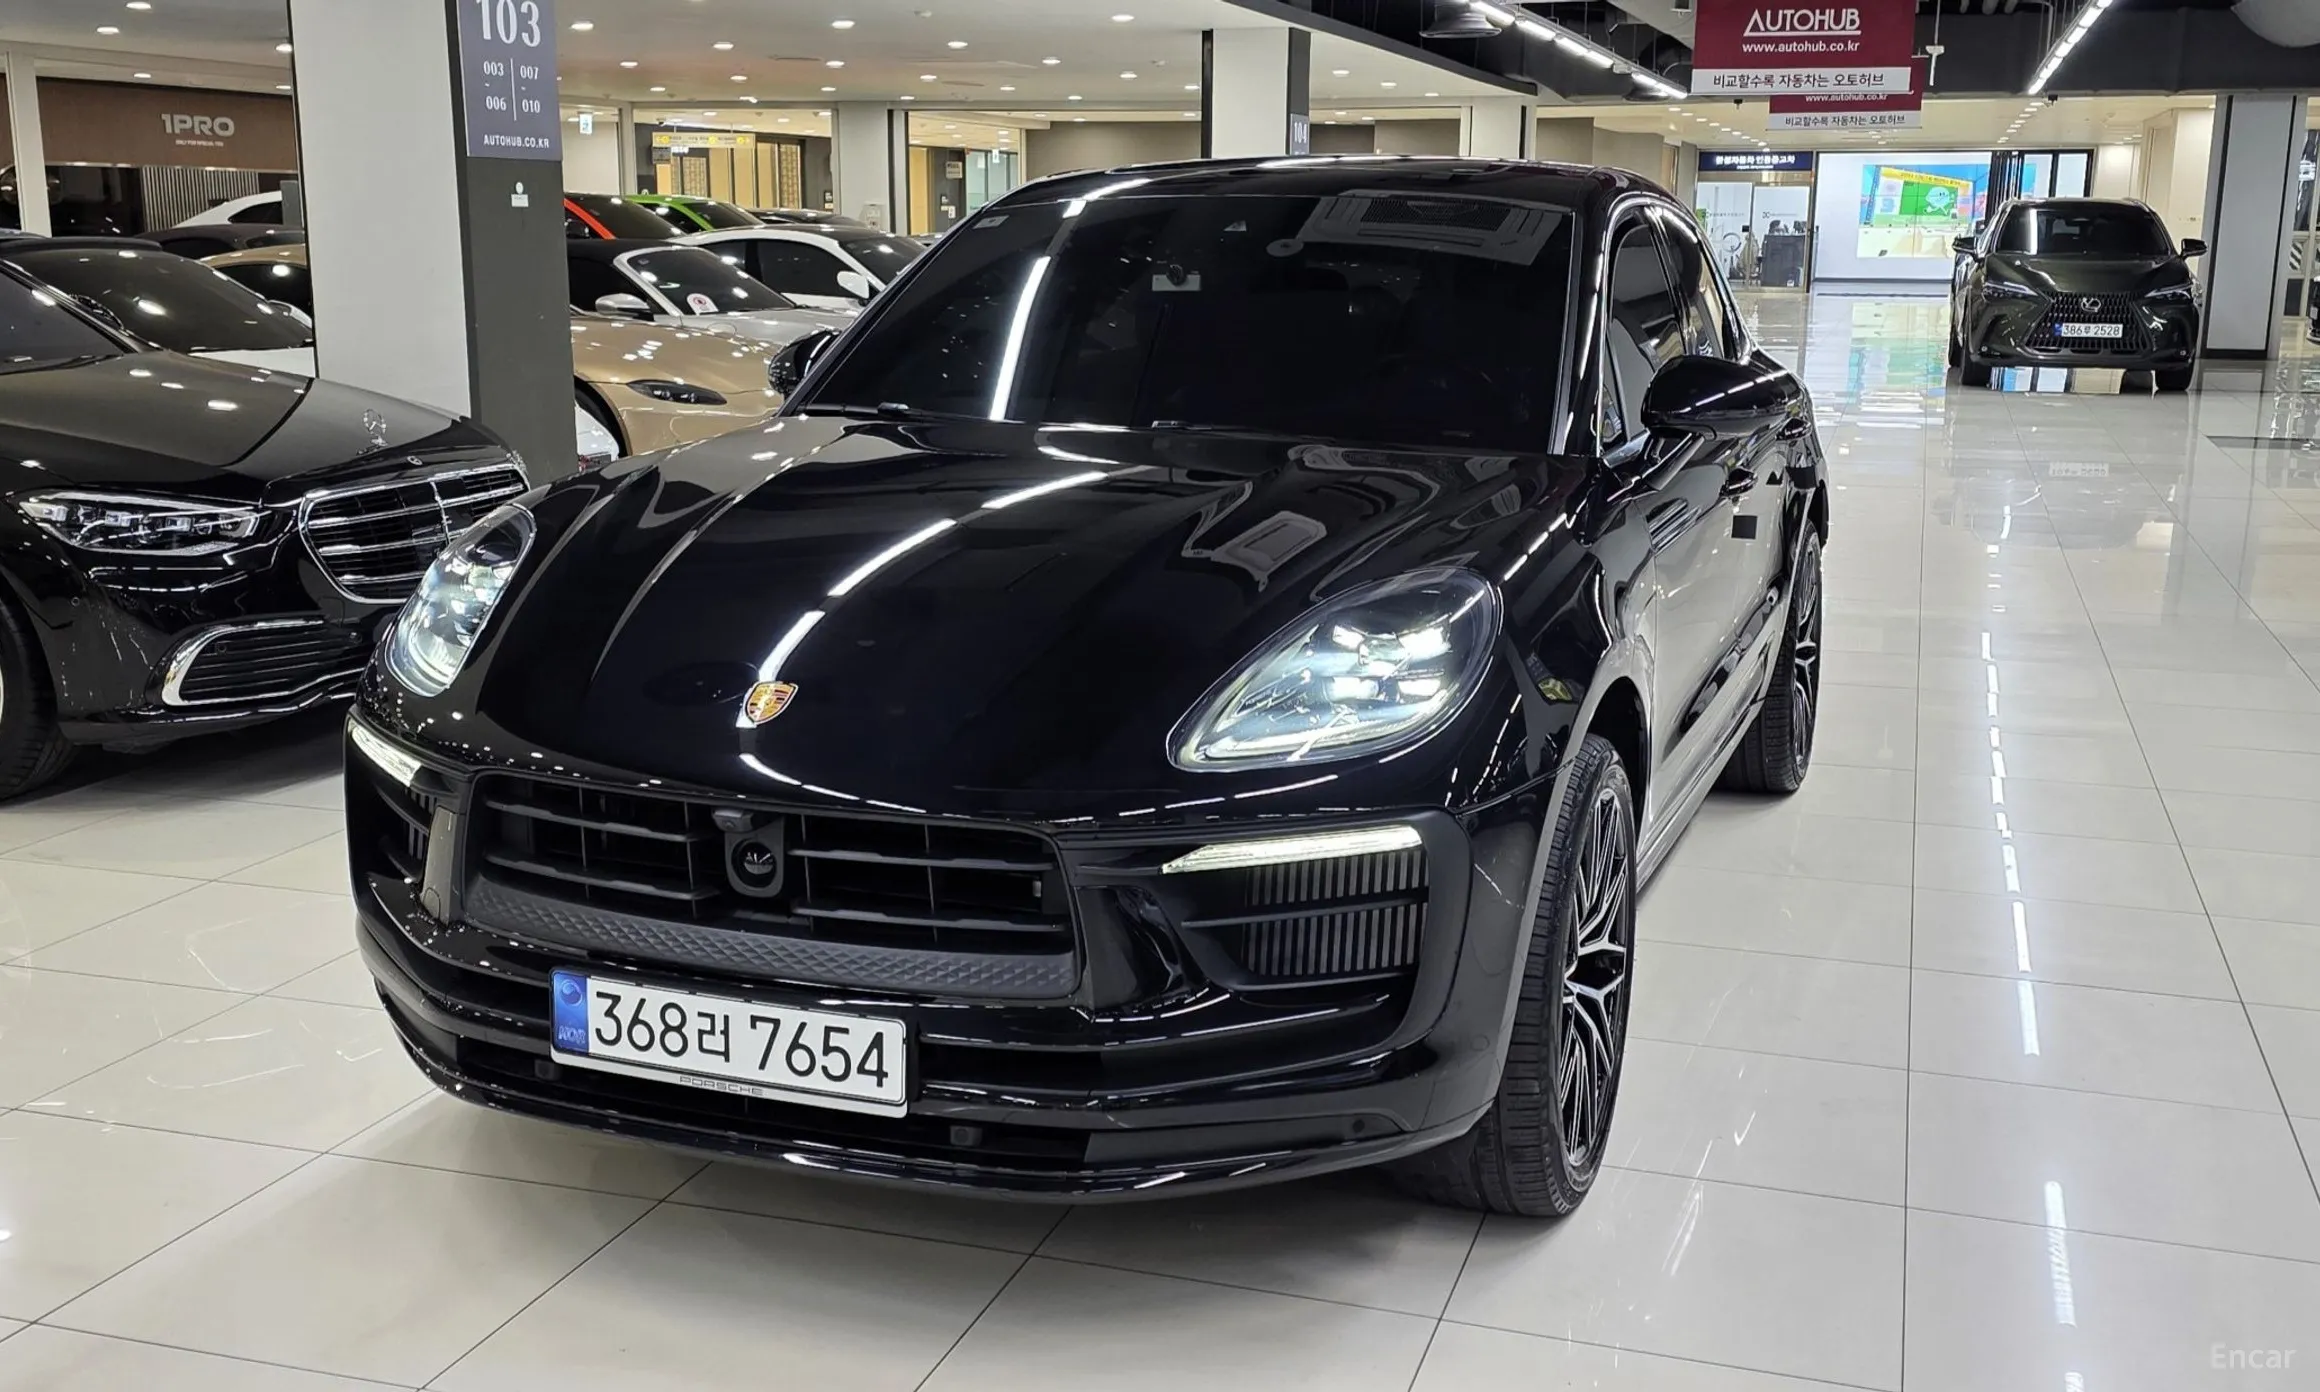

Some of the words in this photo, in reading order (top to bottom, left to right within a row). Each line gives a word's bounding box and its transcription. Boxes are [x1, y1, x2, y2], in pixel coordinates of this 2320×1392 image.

[476, 0, 541, 47] 103
[1743, 8, 1861, 36] AUTOHUB
[1742, 40, 1860, 53] www.autohub.co.kr
[483, 61, 504, 77] 003
[520, 65, 539, 80] 007
[1713, 74, 1775, 89] 비교할수록
[1778, 74, 1830, 88] 자동차는
[1832, 73, 1885, 88] 오토허브
[486, 95, 507, 111] 006
[522, 99, 541, 114] 010
[161, 113, 235, 137] 1PRO
[1785, 116, 1829, 127] 비교할수록
[1831, 116, 1867, 127] 자동차는
[1869, 114, 1906, 126] 오토허브
[484, 134, 549, 149] AUTOHUB.CO.KR
[2093, 325, 2120, 336] 2528
[594, 990, 731, 1065] 368러
[749, 1014, 889, 1089] 7654
[679, 1076, 763, 1097] PORSCHE
